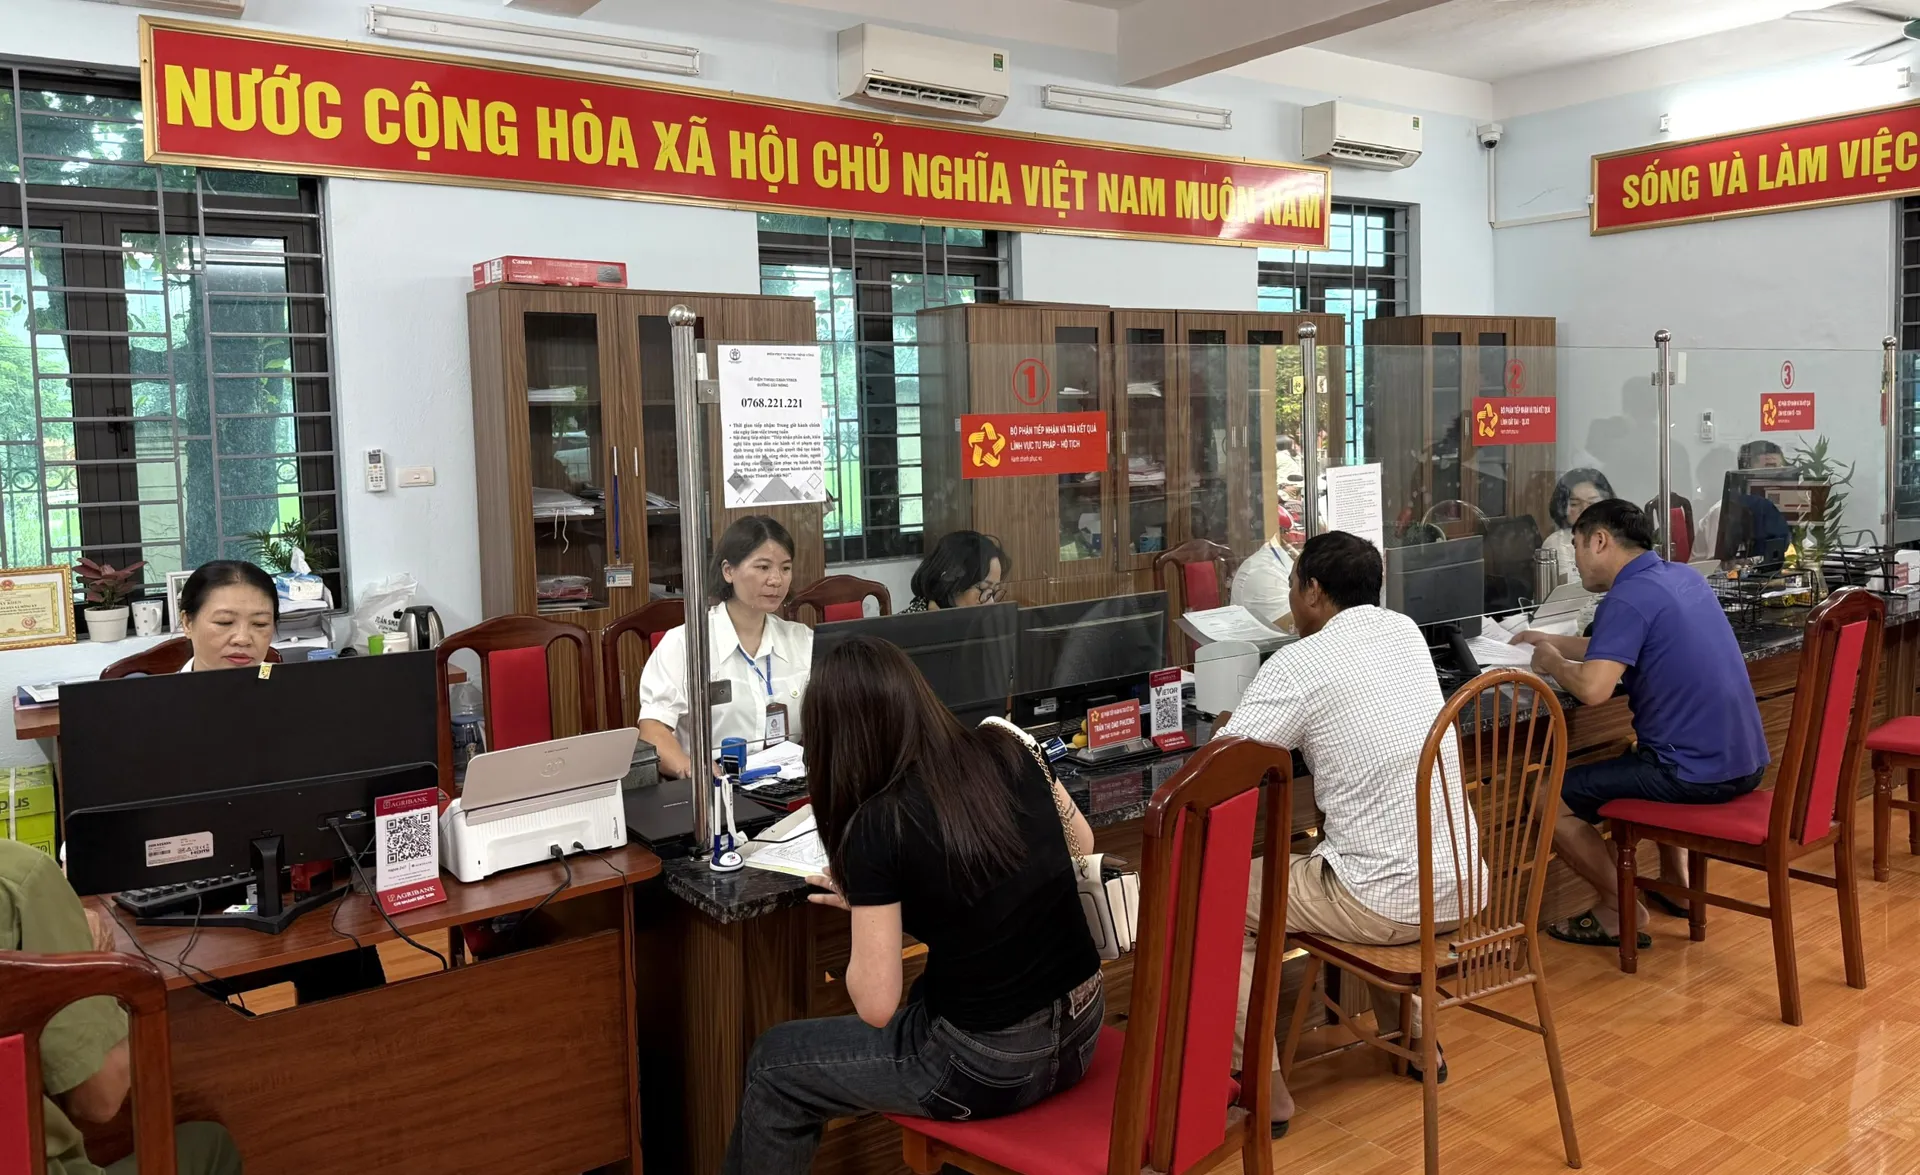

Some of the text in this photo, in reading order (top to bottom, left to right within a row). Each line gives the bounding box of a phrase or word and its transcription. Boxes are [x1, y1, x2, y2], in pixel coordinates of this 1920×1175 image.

[165, 64, 342, 138] NƯỚC
[365, 82, 518, 160] CỘNG
[538, 99, 638, 167] HÒA
[655, 117, 715, 175] XÃ
[730, 125, 798, 193] HỘI
[813, 132, 889, 193] CHỦ
[903, 152, 1011, 204] NGHĨA
[1022, 161, 1087, 217] VIỆT
[1098, 173, 1165, 216] NAM
[1175, 177, 1255, 224] MUÔN
[1622, 127, 1918, 209] SỐNG VÀ LÀM VIỆC
[1022, 365, 1036, 398] 1
[1511, 364, 1522, 389] 2
[1784, 365, 1792, 386] 3
[741, 398, 802, 408] 0768.221.221
[1010, 422, 1097, 437] BỘ PHẬN TIẾP NHẬN VÀ TRẢ KẾT QUẢ
[1024, 441, 1034, 451] VỰC
[1043, 439, 1056, 450] PHÁP
[1061, 439, 1068, 450] HỘ
[1069, 440, 1080, 449] TỊCH
[391, 796, 428, 807] AGRIBANK
[396, 885, 436, 900] AGRIBANK
